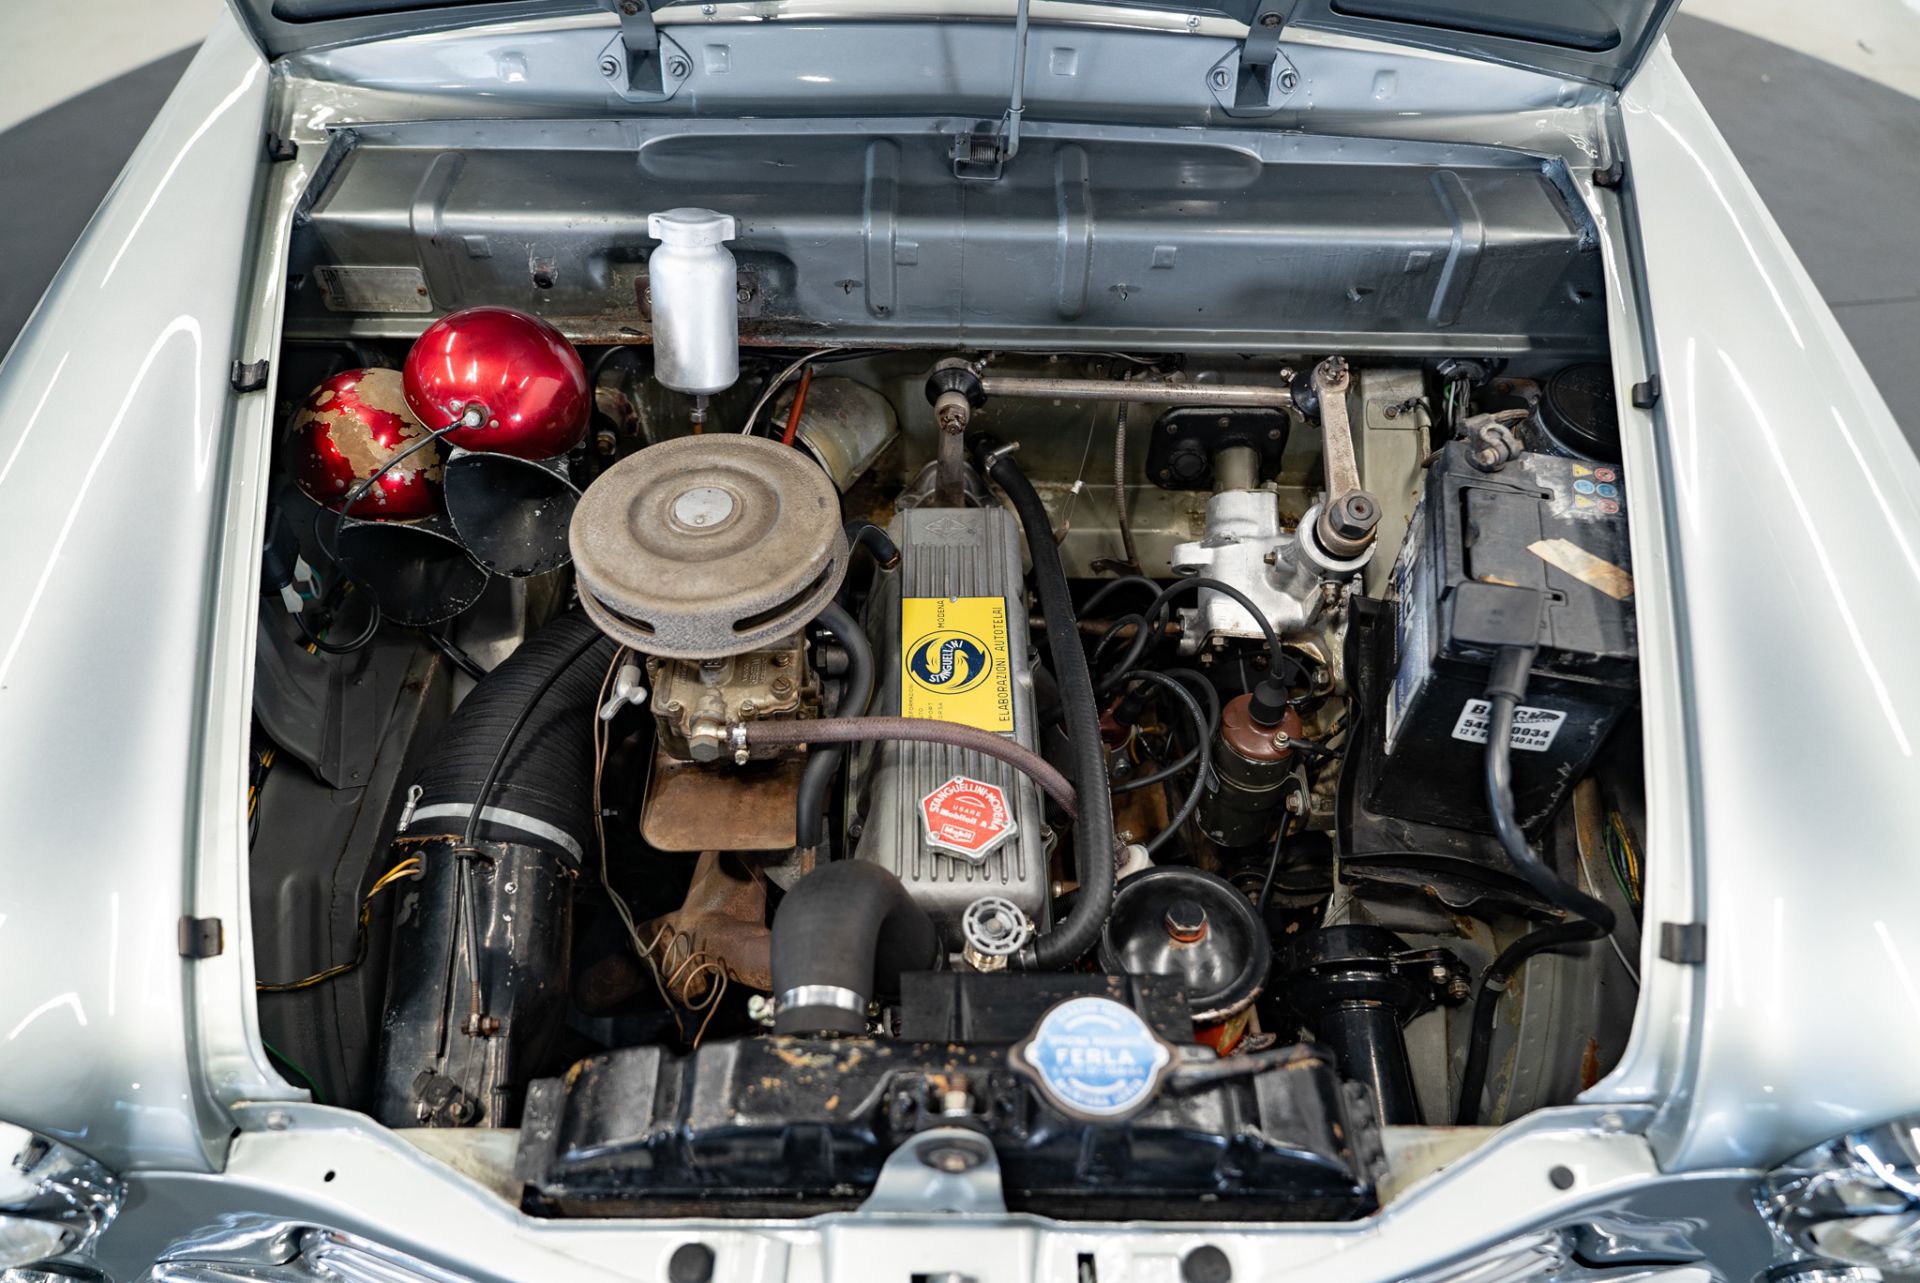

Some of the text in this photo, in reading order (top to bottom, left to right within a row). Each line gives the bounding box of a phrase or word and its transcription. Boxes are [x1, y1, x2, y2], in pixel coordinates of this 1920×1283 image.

[1403, 532, 1416, 641] Black
[937, 600, 945, 629] MODENA
[928, 640, 963, 683] STANGUELLINI
[992, 607, 1011, 722] ELABORAZIONI AUTOTELAI
[939, 808, 978, 825] Mobiloil
[952, 804, 982, 817] USARE
[944, 826, 973, 840] Mobil
[1054, 1047, 1136, 1067] FERLA
